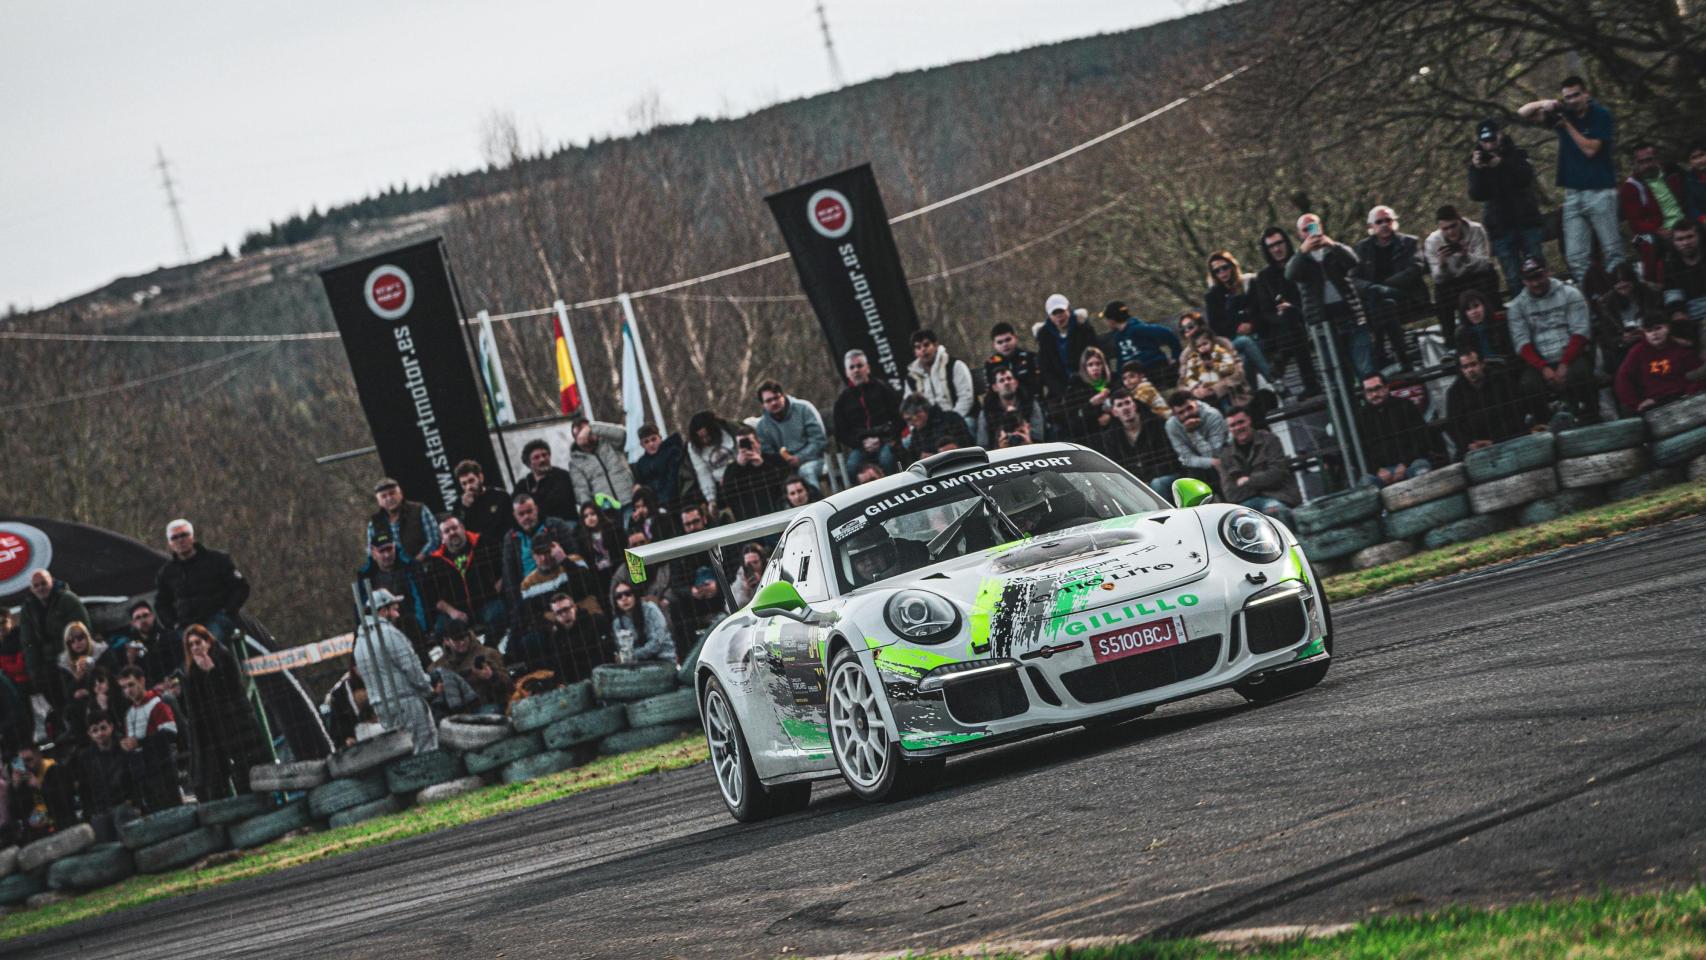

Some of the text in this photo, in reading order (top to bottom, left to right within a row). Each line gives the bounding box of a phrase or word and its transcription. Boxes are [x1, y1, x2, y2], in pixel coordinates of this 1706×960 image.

[865, 456, 1073, 517] GILILLO MOTORSPORT
[1111, 563, 1174, 580] LITO
[1064, 593, 1200, 637] GILILLO
